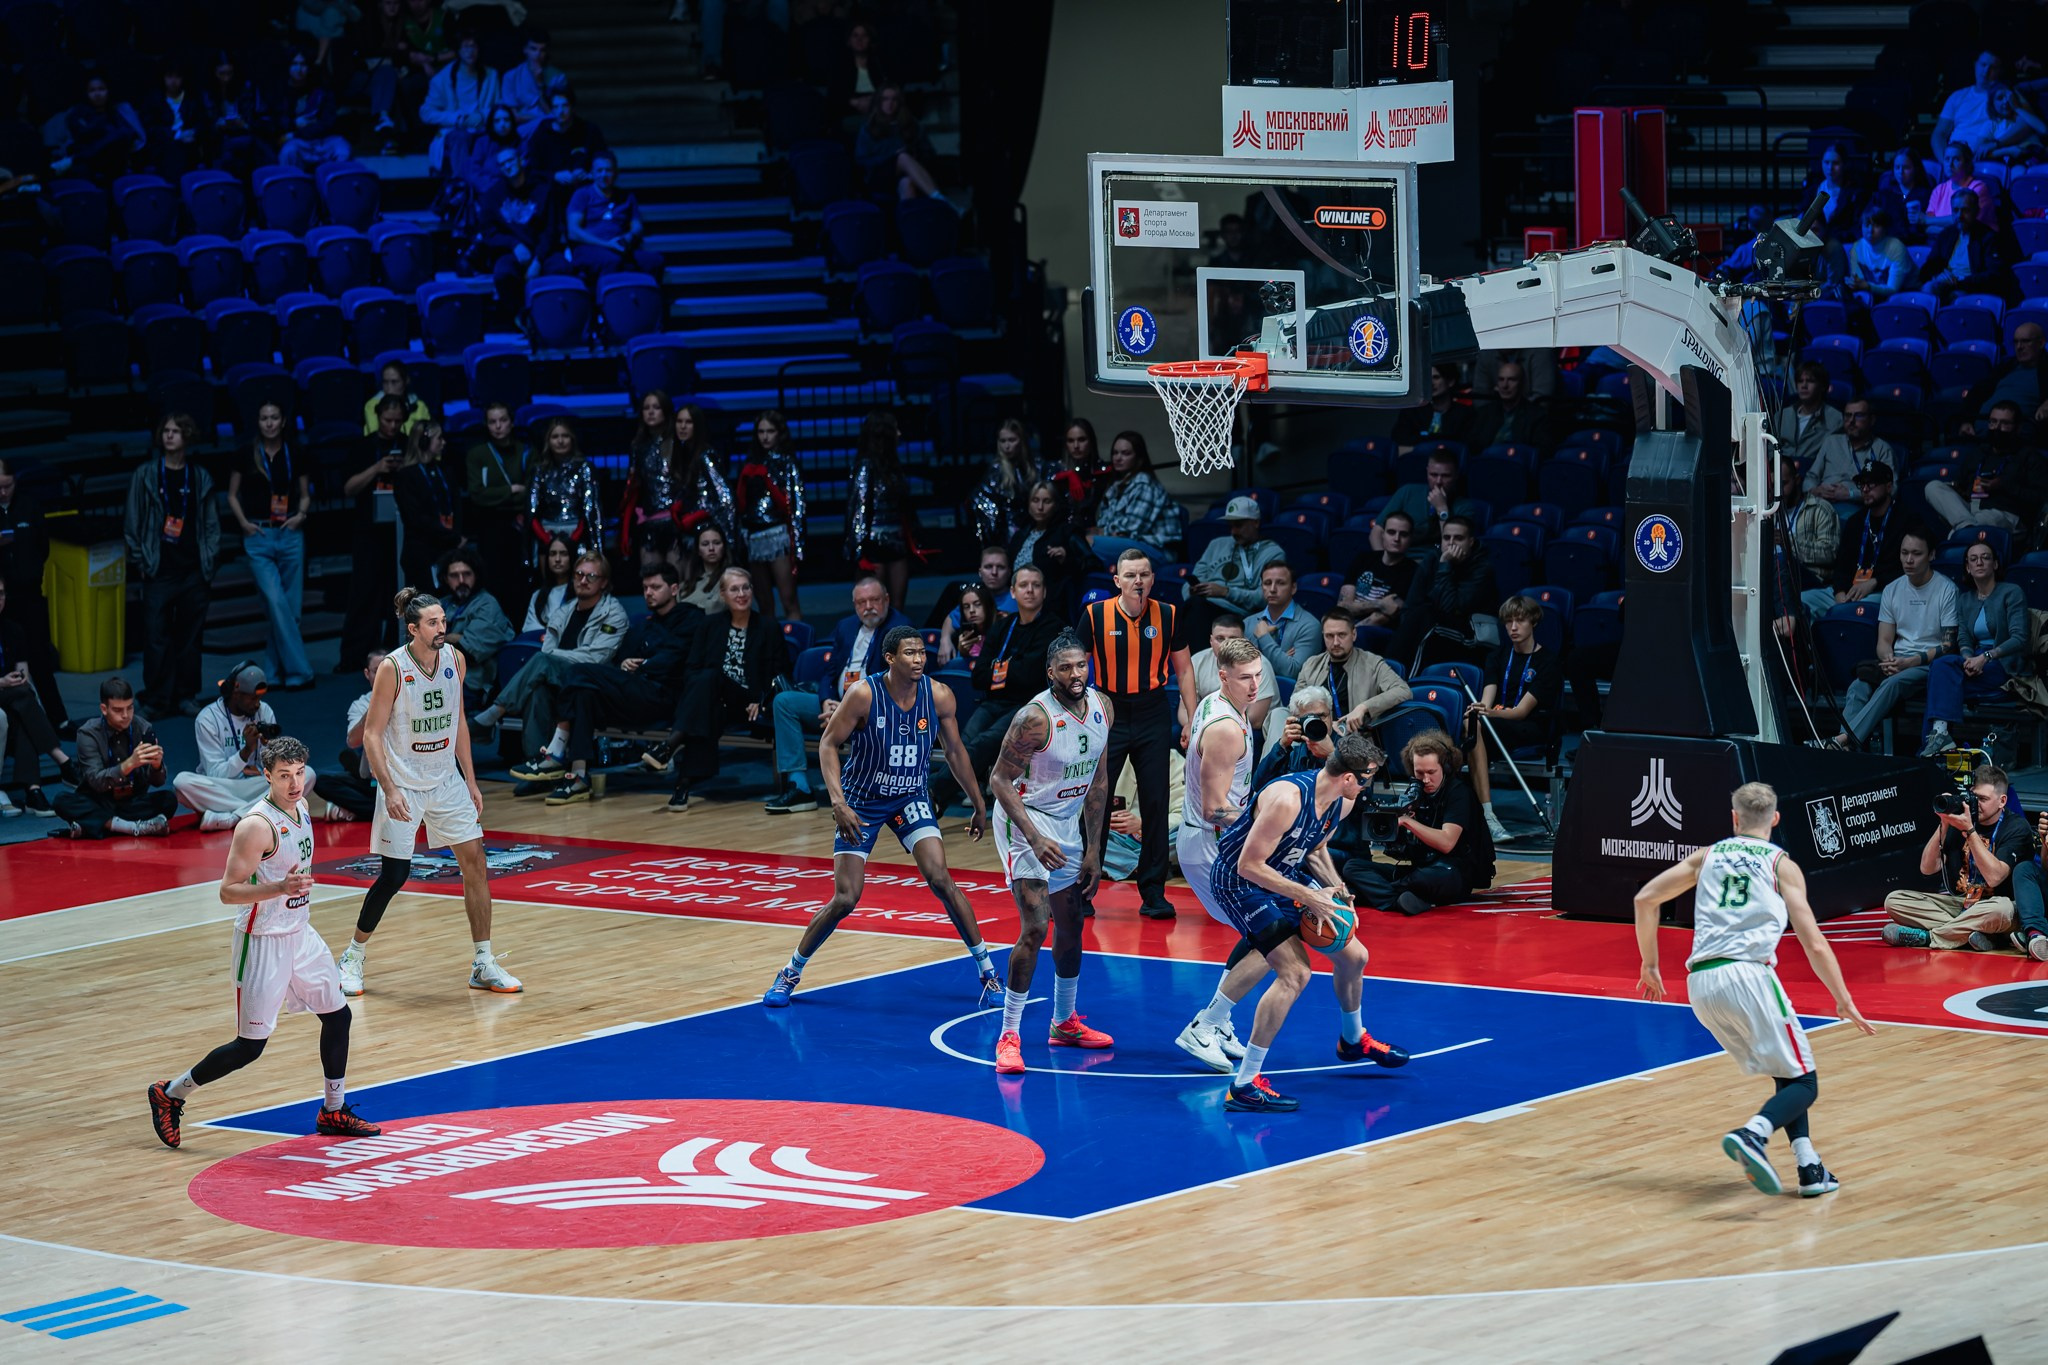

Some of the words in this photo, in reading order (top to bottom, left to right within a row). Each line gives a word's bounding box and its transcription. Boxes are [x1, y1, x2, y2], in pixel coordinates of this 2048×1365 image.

[1393, 12, 1429, 69] 10
[1266, 108, 1349, 132] МОСКОВСКИЙ
[1388, 101, 1448, 128] МОСКОВСКИЙ
[1266, 131, 1305, 151] СПОРТ
[1389, 128, 1417, 148] СПОРТ
[1144, 208, 1188, 218] Департамент
[1144, 219, 1167, 228] спорта
[1320, 210, 1371, 225] WINLINE
[1144, 229, 1168, 238] города
[1169, 229, 1196, 238] Москвы
[1681, 327, 1724, 381] SPALDING
[423, 689, 444, 711] 95
[412, 713, 452, 733] UNICS
[415, 740, 445, 751] WINLINE
[1078, 734, 1088, 754] 3
[888, 745, 918, 767] 88
[875, 771, 922, 787] ANADOLU
[1841, 786, 1898, 812] Департамент
[903, 801, 933, 824] 88
[1845, 811, 1876, 828] спорта
[1850, 829, 1881, 848] города
[1881, 821, 1917, 838] Москвы
[298, 838, 312, 861] 38
[1601, 838, 1675, 861] МОСКОВСКИЙ
[525, 880, 741, 904] города
[589, 869, 797, 892] спорта
[1718, 874, 1751, 909] 13
[264, 1112, 676, 1202] МОСКОВСКИЙ
[274, 1123, 495, 1168] СПОРТ
